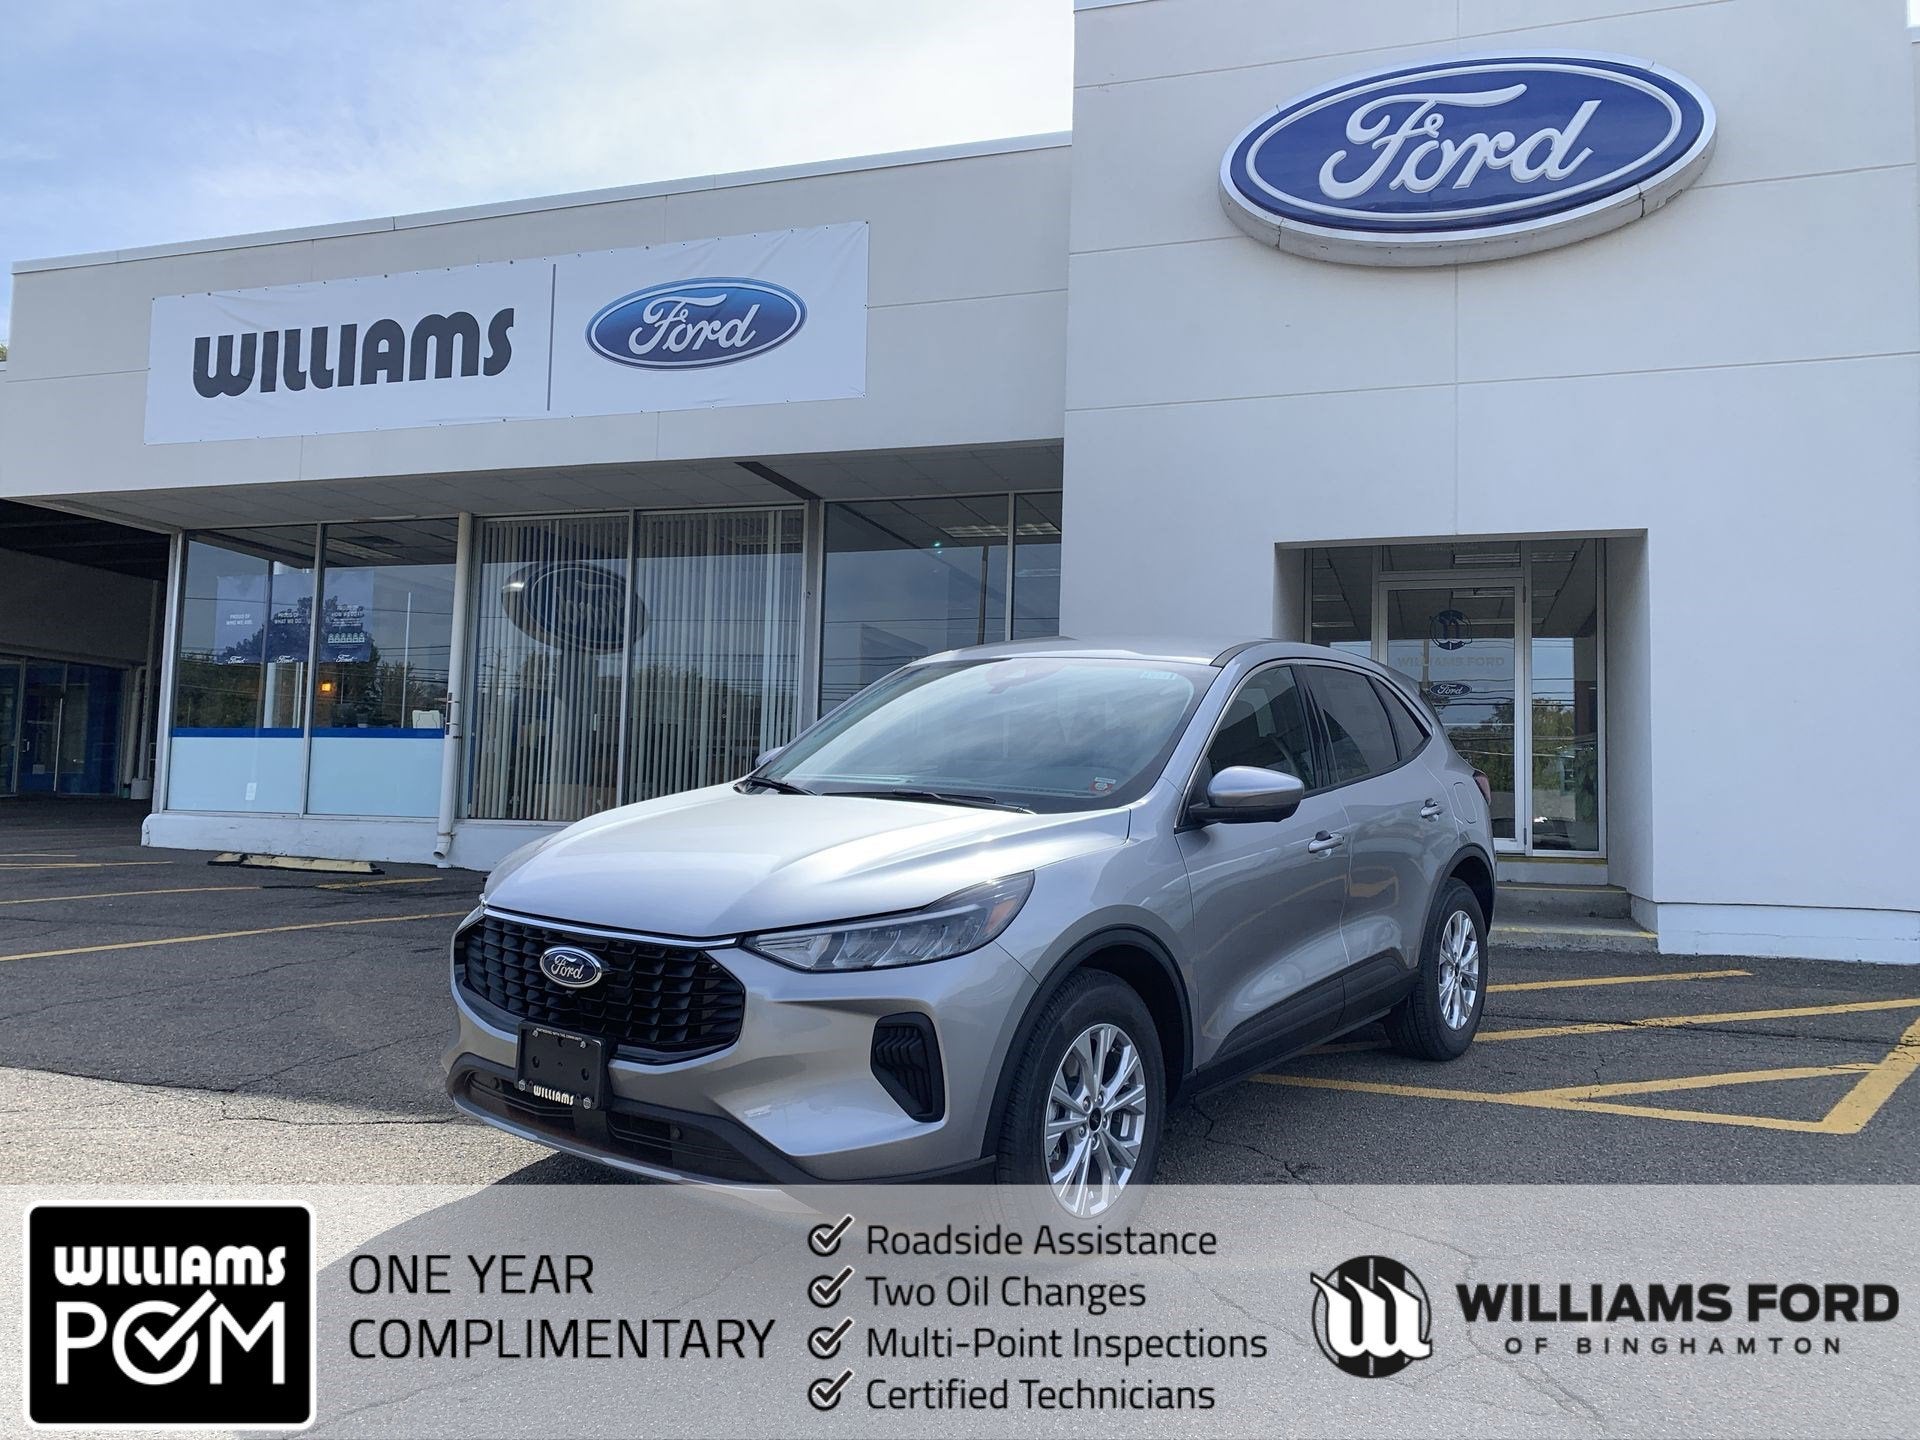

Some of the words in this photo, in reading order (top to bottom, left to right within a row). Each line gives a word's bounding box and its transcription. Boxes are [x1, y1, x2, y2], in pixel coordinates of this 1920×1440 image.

[1318, 83, 1602, 200] Ford
[628, 293, 760, 355] Ford
[193, 308, 514, 398] WILLIAMS
[1467, 656, 1504, 667] FORD
[1437, 684, 1463, 695] Ford
[551, 954, 584, 980] Ford
[533, 1085, 575, 1106] WILLIAMS
